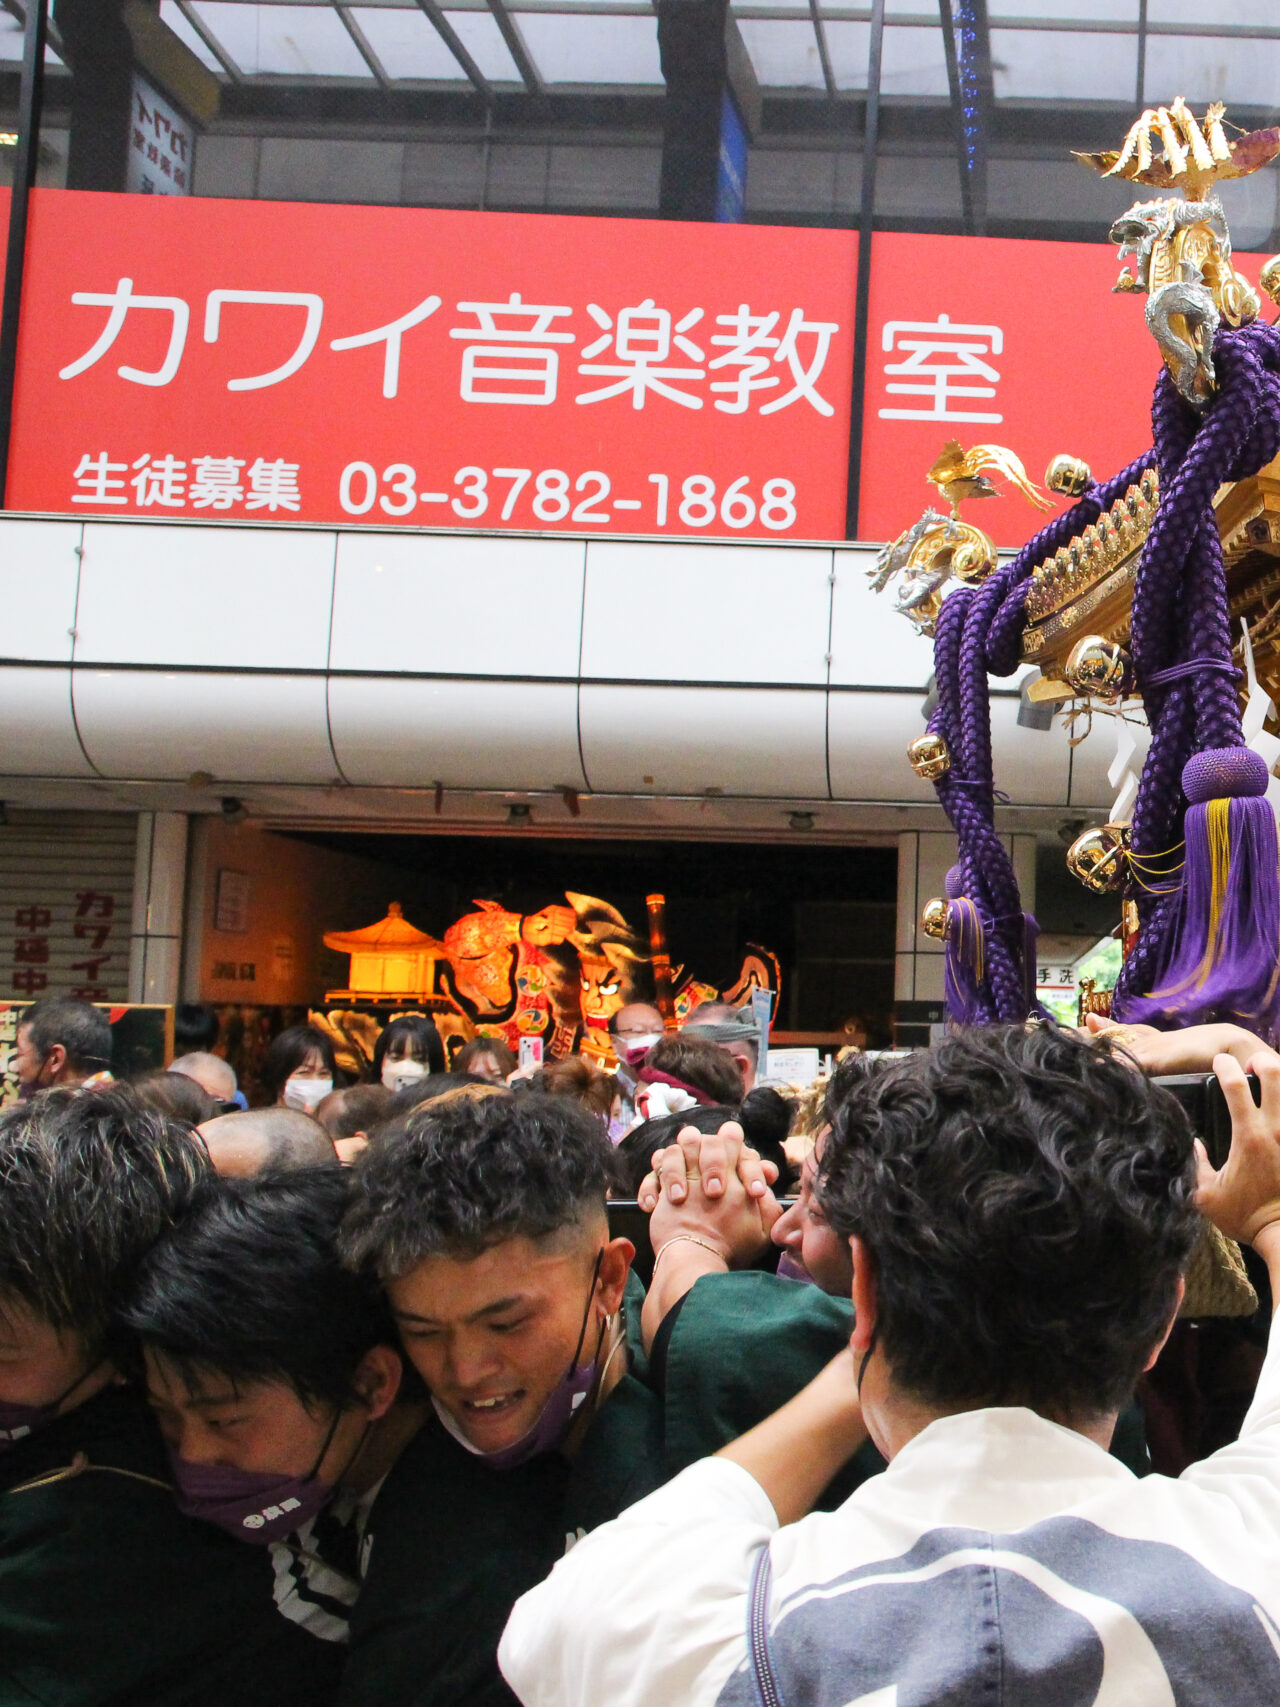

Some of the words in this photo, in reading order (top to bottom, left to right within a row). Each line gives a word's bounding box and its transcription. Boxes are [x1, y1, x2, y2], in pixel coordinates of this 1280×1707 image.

[59, 277, 1004, 425] カワイ音楽教室
[73, 451, 302, 512] 生徒募集
[340, 461, 797, 530] 03-3782-1868
